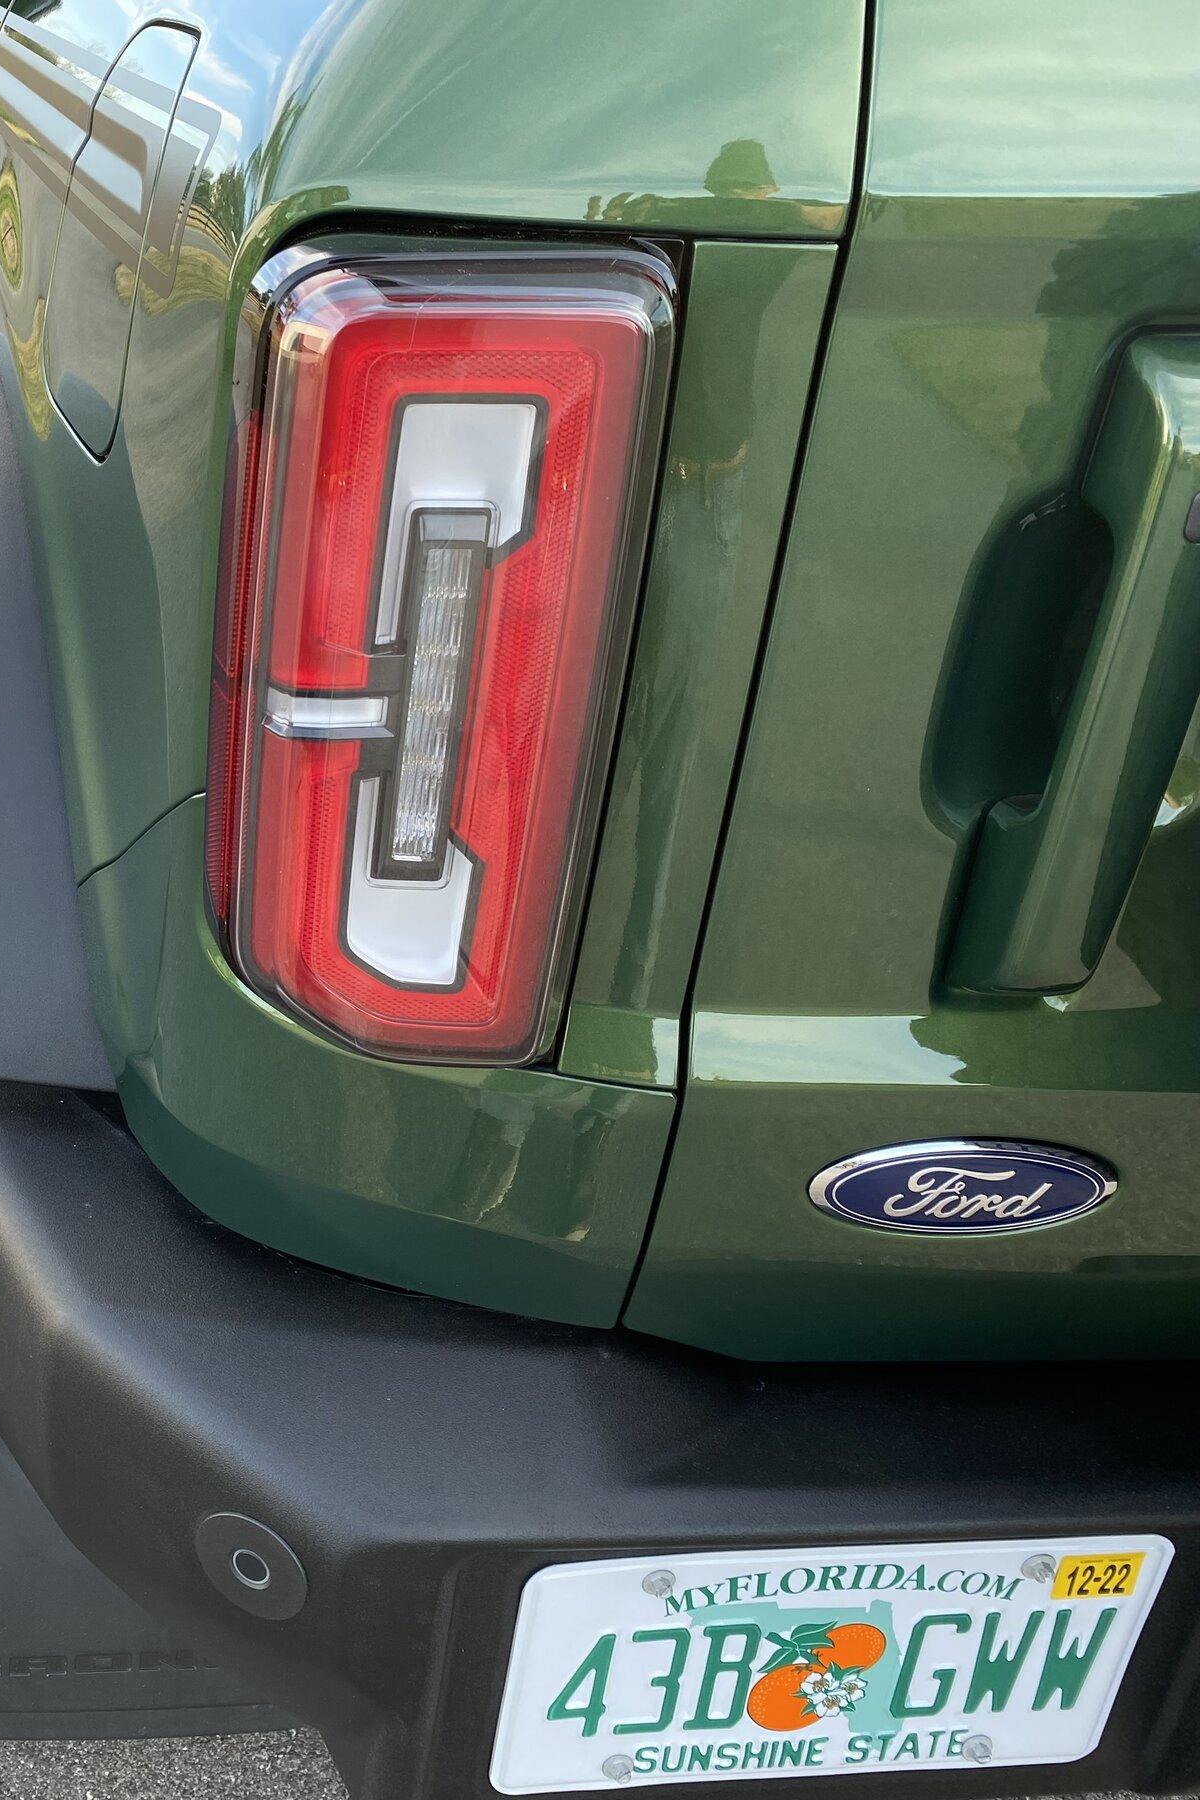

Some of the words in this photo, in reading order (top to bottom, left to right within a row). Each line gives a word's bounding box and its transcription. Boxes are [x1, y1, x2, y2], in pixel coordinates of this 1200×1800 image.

[883, 1166, 1052, 1219] Ford
[664, 1563, 1025, 1617] MYFLORIDA.COM
[1067, 1563, 1131, 1597] 12-22
[546, 1622, 763, 1738] 43B
[889, 1606, 1119, 1720] GWW
[632, 1736, 829, 1774] SUNSHINE
[844, 1728, 970, 1765] STATE
